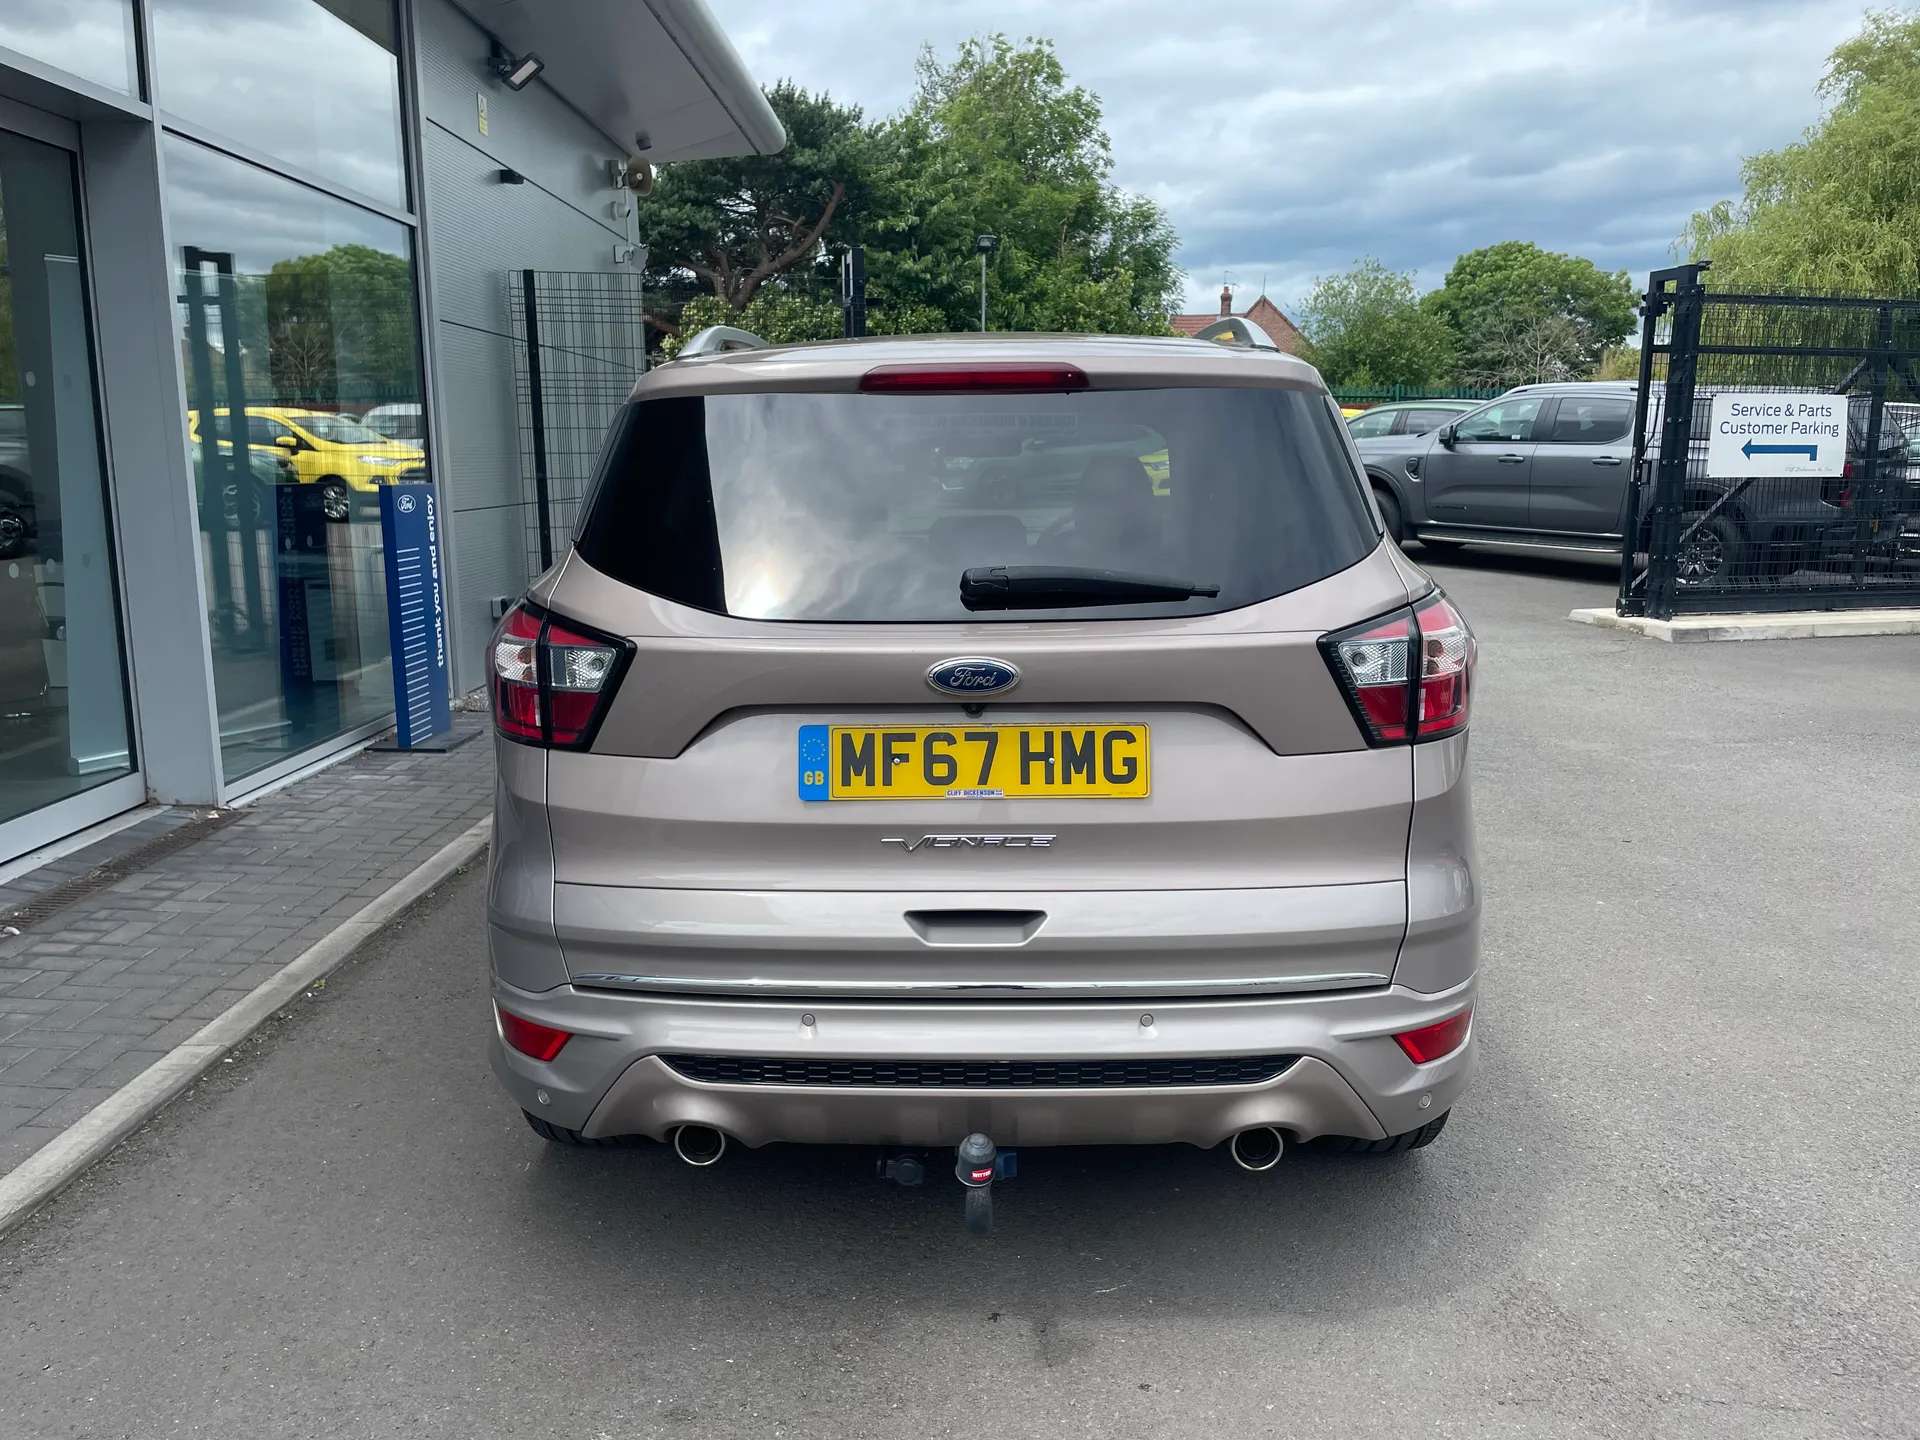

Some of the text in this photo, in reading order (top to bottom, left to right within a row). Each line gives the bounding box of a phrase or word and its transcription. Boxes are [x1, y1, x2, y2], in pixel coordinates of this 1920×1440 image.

[1730, 403, 1832, 417] Service & Parts
[1719, 421, 1840, 438] Customer Parking
[426, 494, 444, 668] thank you and enjoy
[950, 667, 998, 687] Ford
[840, 730, 1138, 787] MF67 HMG
[803, 771, 824, 785] GB
